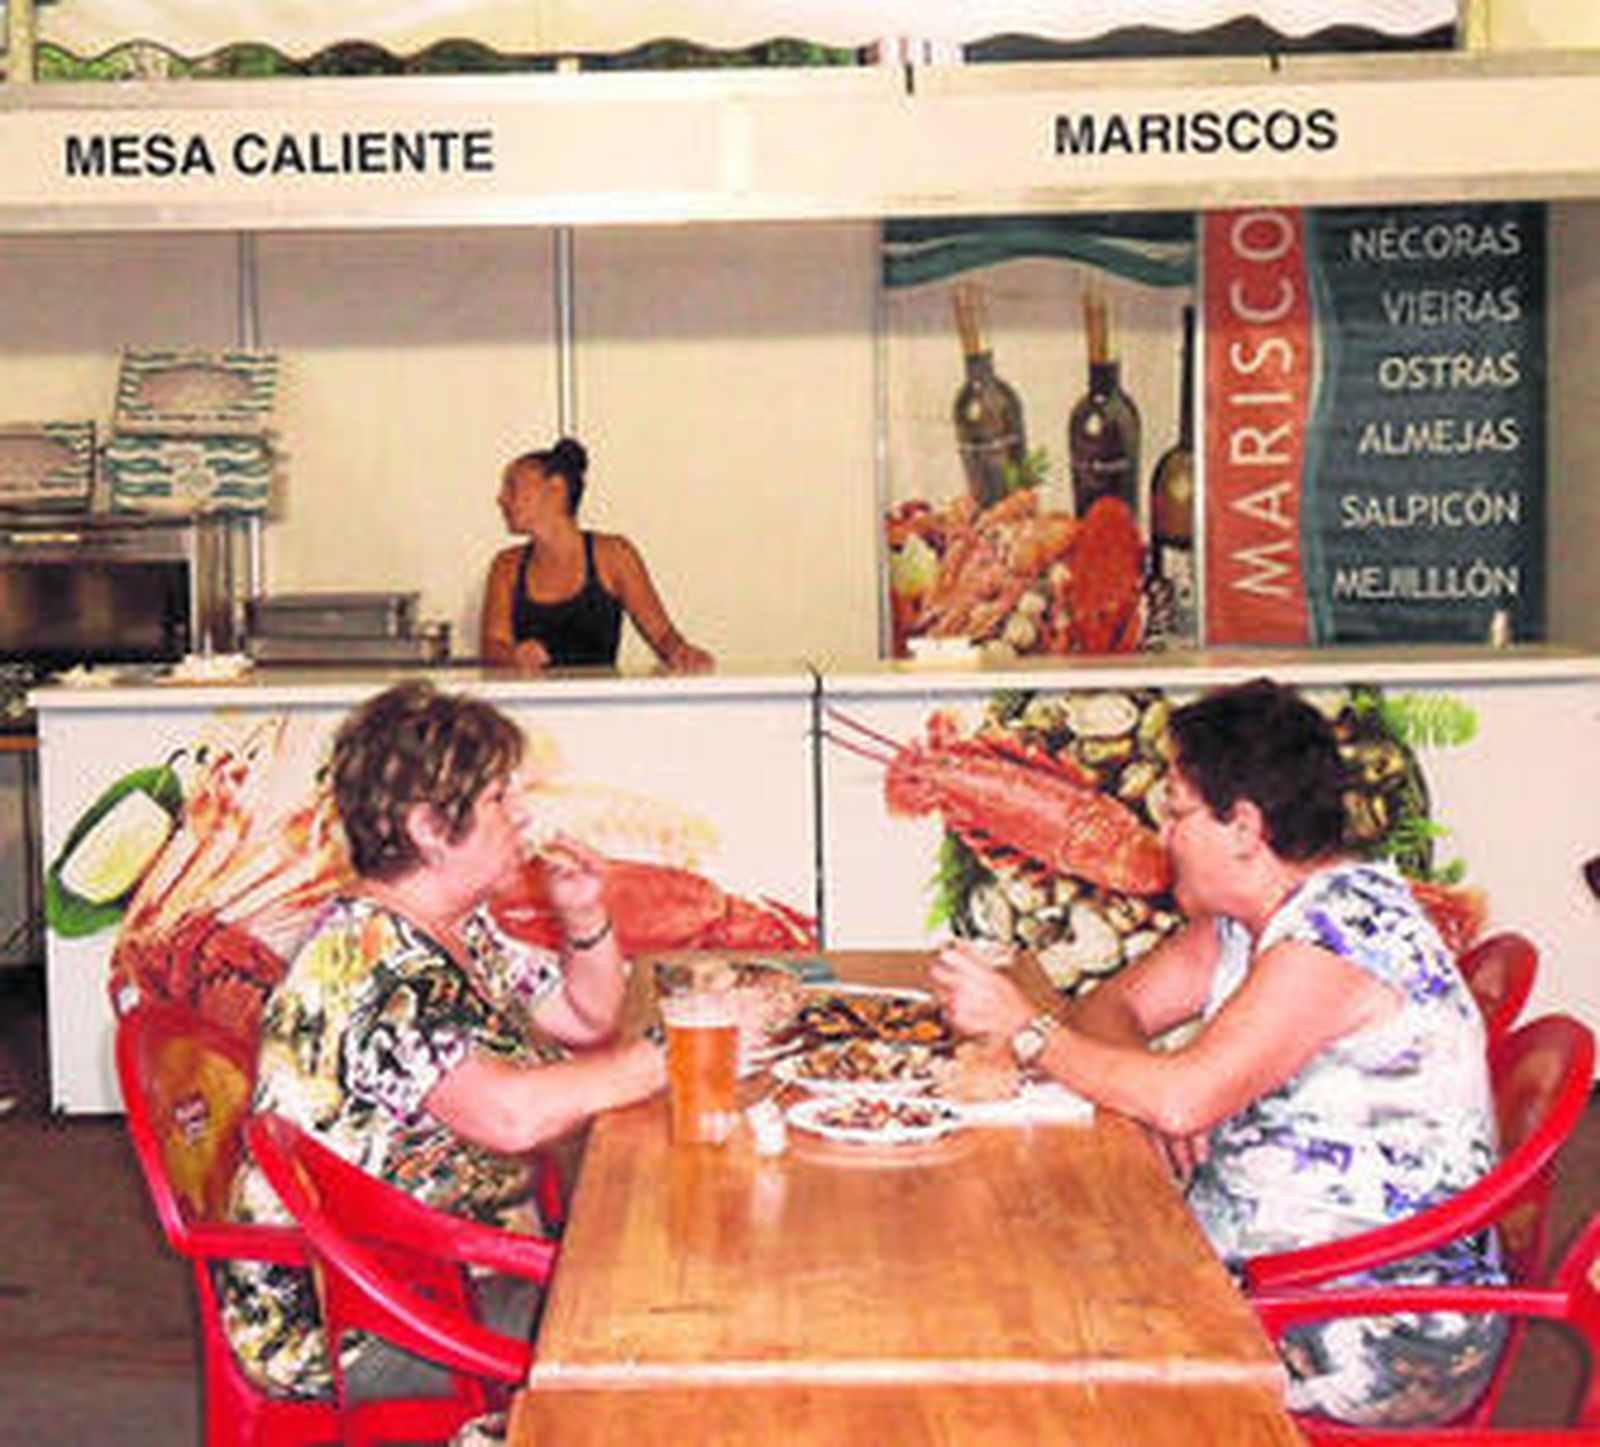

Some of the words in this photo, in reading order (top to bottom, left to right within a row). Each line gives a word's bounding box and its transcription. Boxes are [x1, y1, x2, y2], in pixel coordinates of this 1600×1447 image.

[1054, 109, 1338, 154] MARISCOS
[64, 133, 215, 177] MESA
[232, 131, 495, 175] CALIENTE
[1351, 219, 1522, 260] NÉCORAS
[1381, 286, 1521, 324] VIEIRAS
[1378, 352, 1521, 389] OSTRAS
[1229, 211, 1294, 597] MARISCO
[1357, 417, 1521, 455] ALMEJAS
[1340, 486, 1520, 527] SALPICÓN
